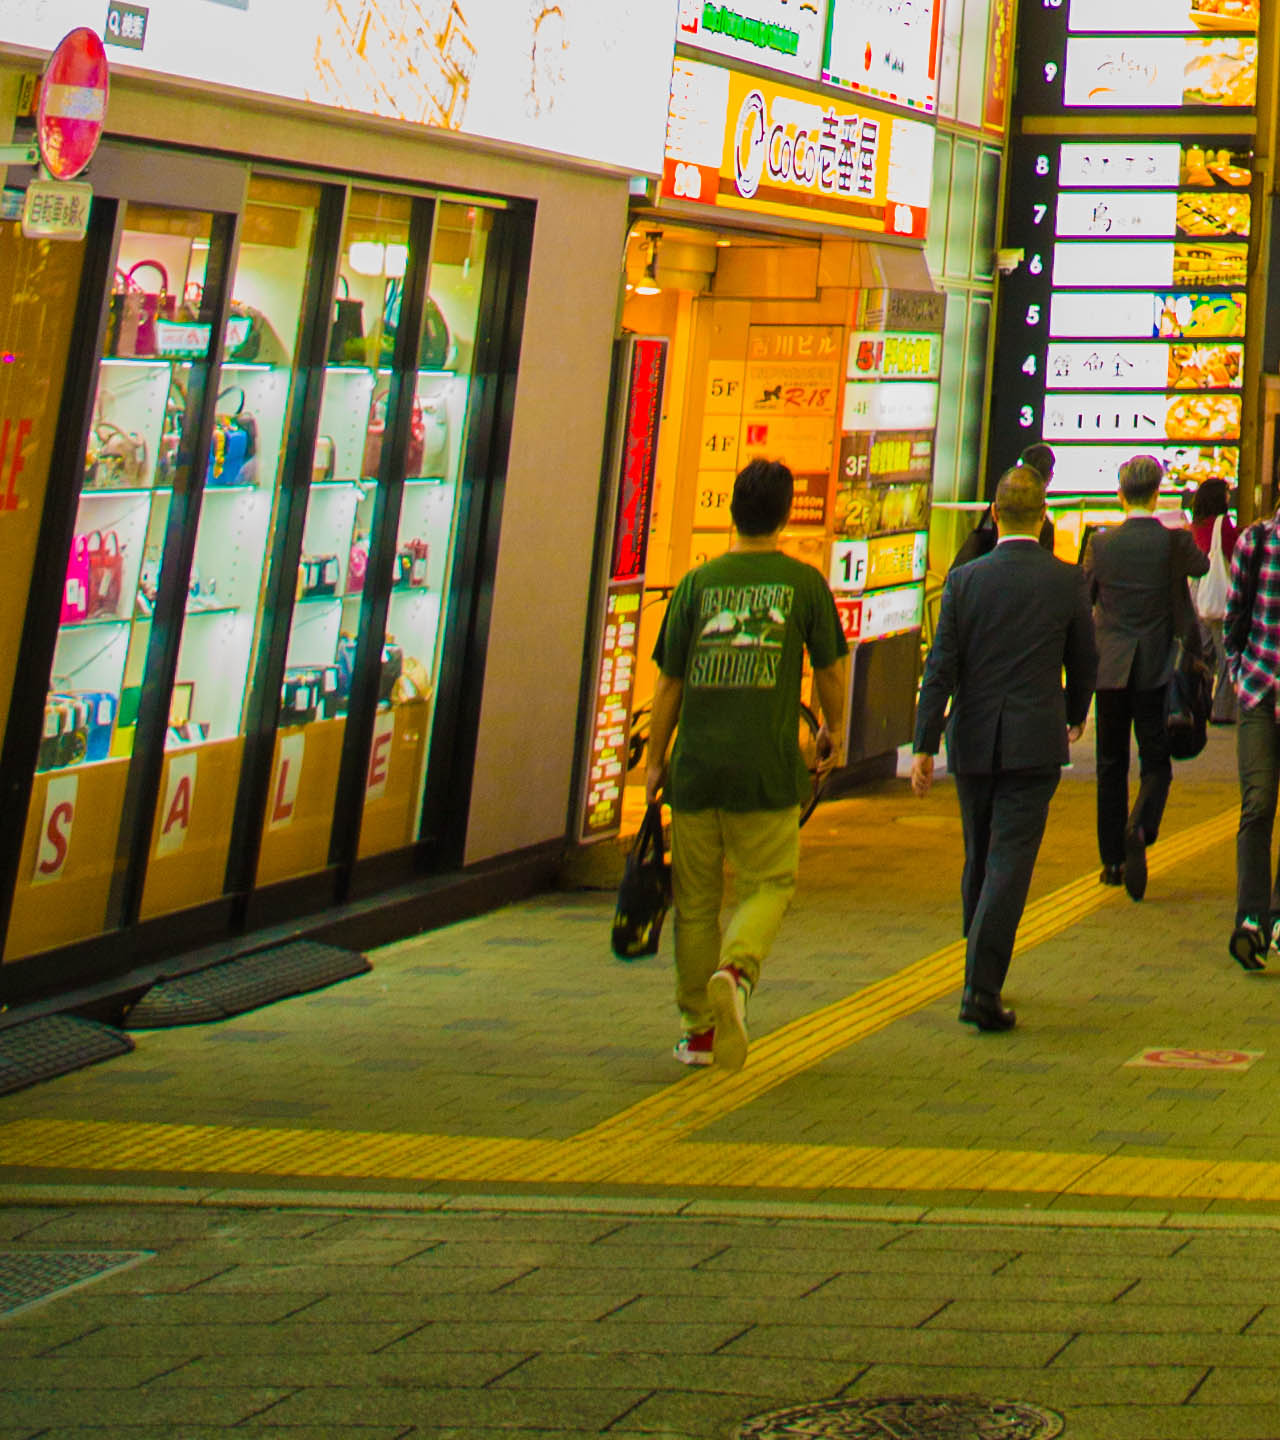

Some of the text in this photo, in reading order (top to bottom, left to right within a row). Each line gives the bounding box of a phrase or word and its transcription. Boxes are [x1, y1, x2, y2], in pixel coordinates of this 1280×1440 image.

[1043, 61, 1058, 82] 9
[1034, 154, 1050, 176] 8
[1032, 203, 1048, 225] 7
[1028, 254, 1043, 275] 6
[1024, 304, 1041, 326] 5
[1020, 354, 1037, 376] 4
[1018, 405, 1034, 428] 3
[839, 549, 865, 583] 1F
